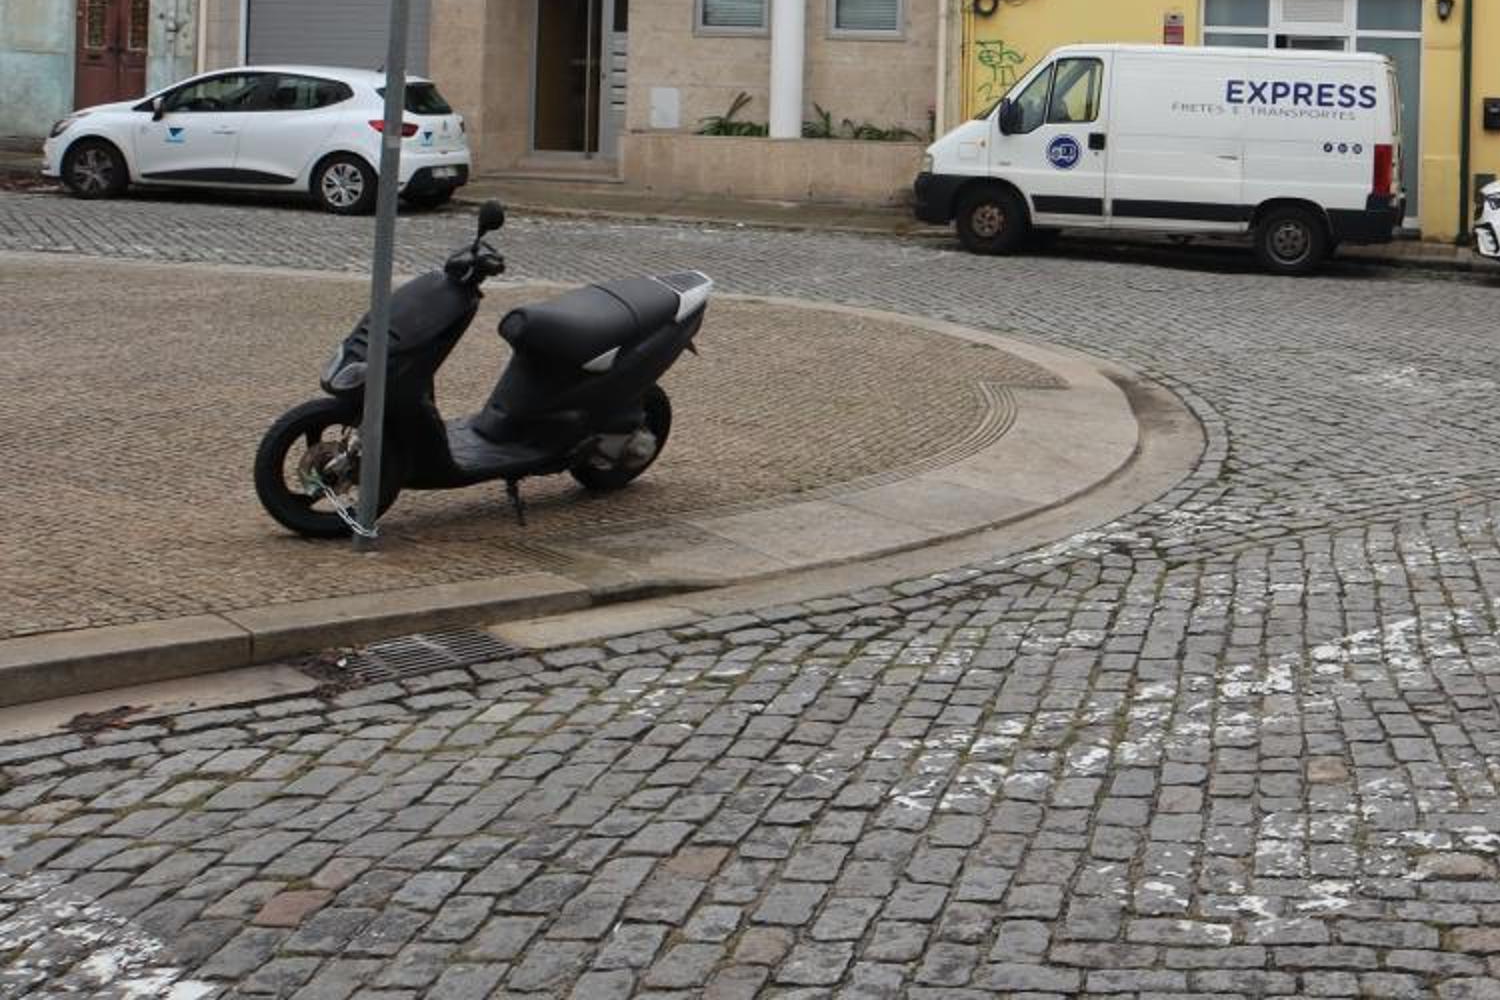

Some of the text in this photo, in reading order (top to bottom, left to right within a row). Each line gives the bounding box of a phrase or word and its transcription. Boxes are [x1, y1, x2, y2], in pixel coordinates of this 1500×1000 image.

[1225, 79, 1377, 109] EXPRESS
[1171, 101, 1225, 115] FRETES
[1250, 105, 1356, 121] TRANSPORTES
